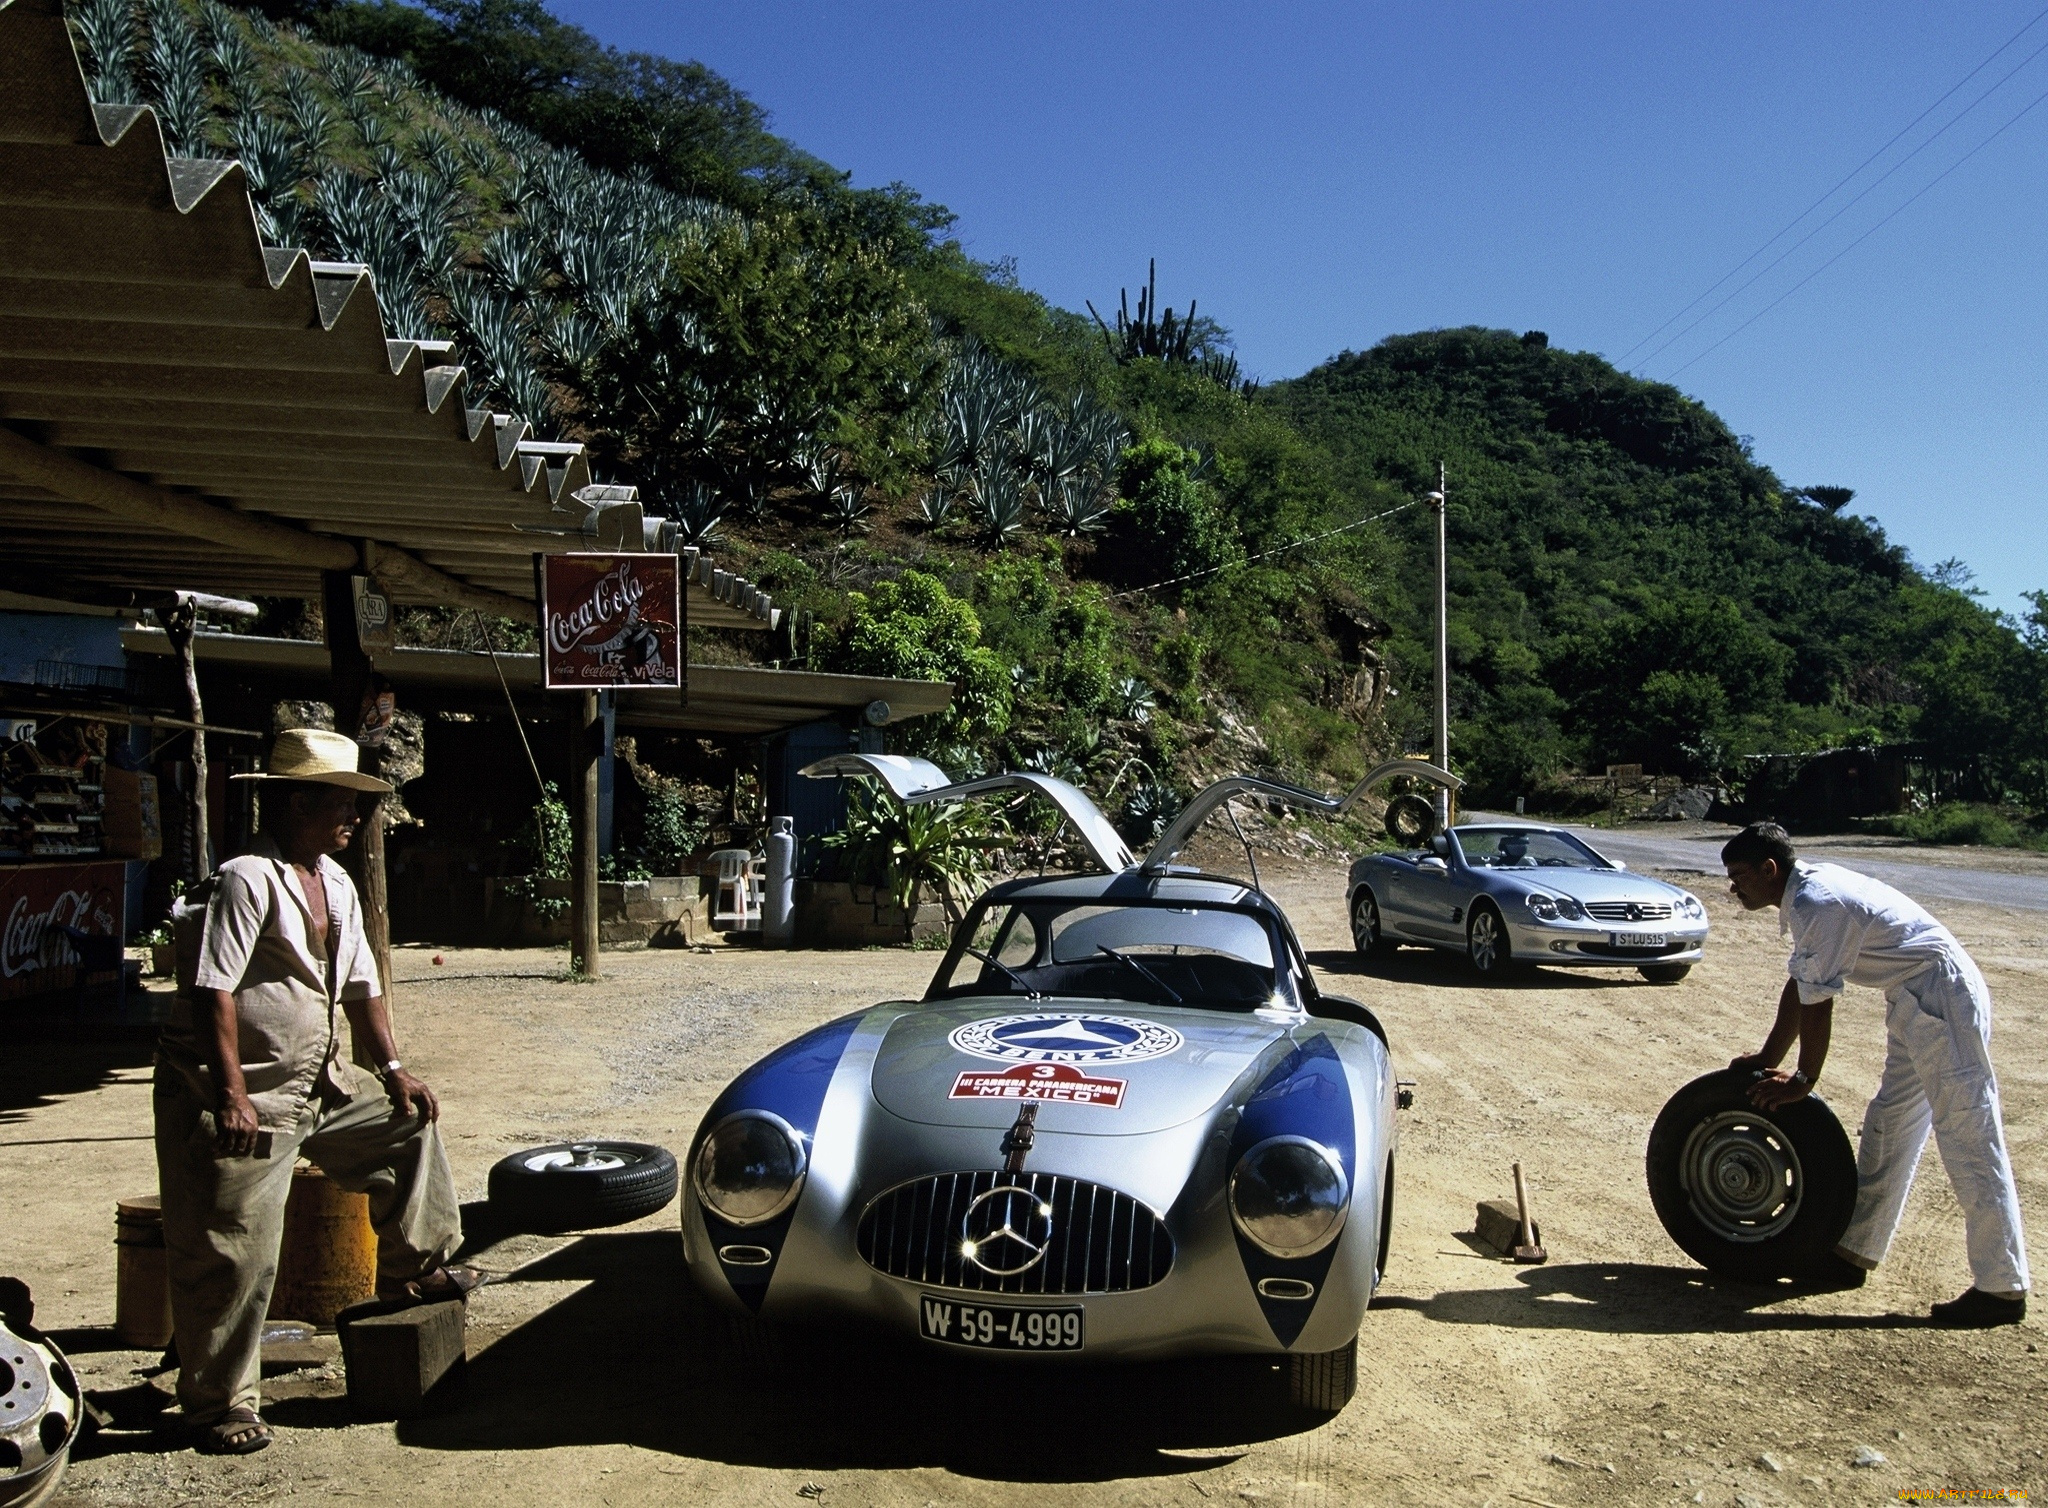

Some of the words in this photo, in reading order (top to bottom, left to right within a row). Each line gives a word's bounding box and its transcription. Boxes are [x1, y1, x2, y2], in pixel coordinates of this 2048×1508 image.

[550, 560, 643, 654] Coca-Cola
[1001, 1047, 1100, 1061] BENZ
[1032, 1065, 1055, 1078] 3
[974, 1078, 1027, 1088] CARRERA
[1028, 1079, 1119, 1096] PANAMERICANA
[924, 1300, 952, 1338] W
[960, 1307, 1080, 1347] 59-4999
